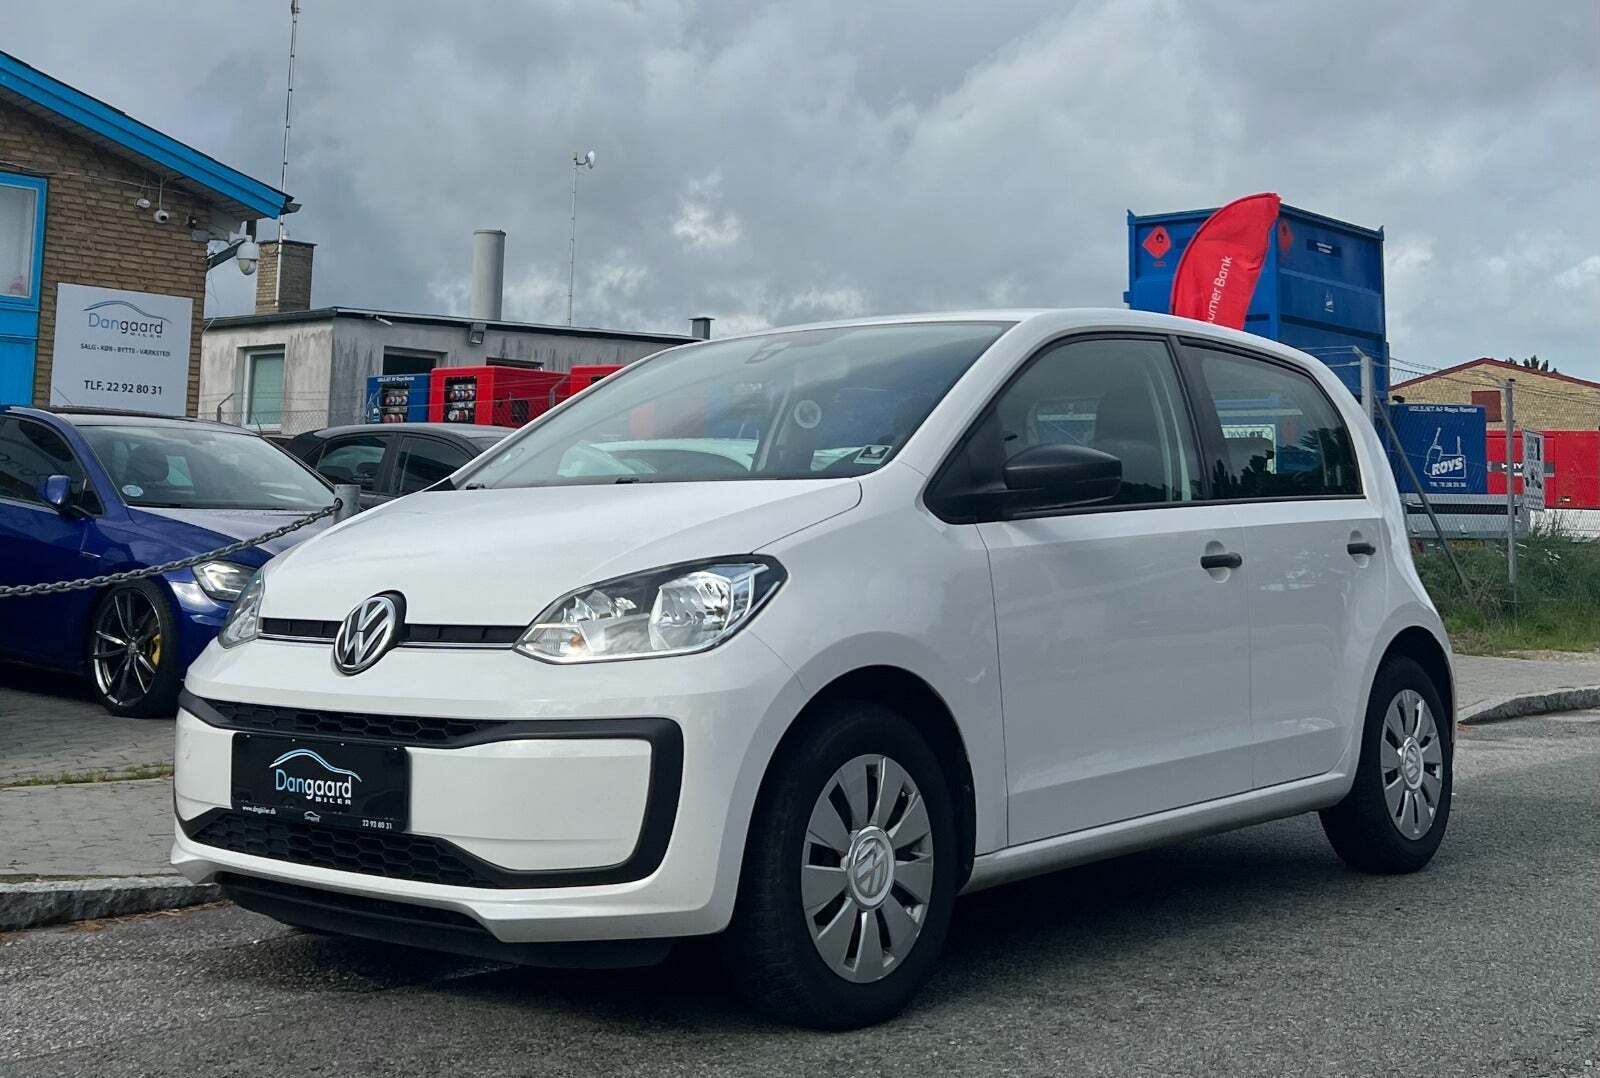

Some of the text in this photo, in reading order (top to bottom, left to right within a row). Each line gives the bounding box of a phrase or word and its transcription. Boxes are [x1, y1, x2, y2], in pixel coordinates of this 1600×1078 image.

[1207, 255, 1233, 323] umer Bank
[88, 312, 163, 334] Dangaard
[84, 379, 162, 396] TLF. 22 92 80 31
[1431, 456, 1464, 476] ROYS
[275, 769, 352, 799] Dangaard
[315, 796, 352, 806] BILER
